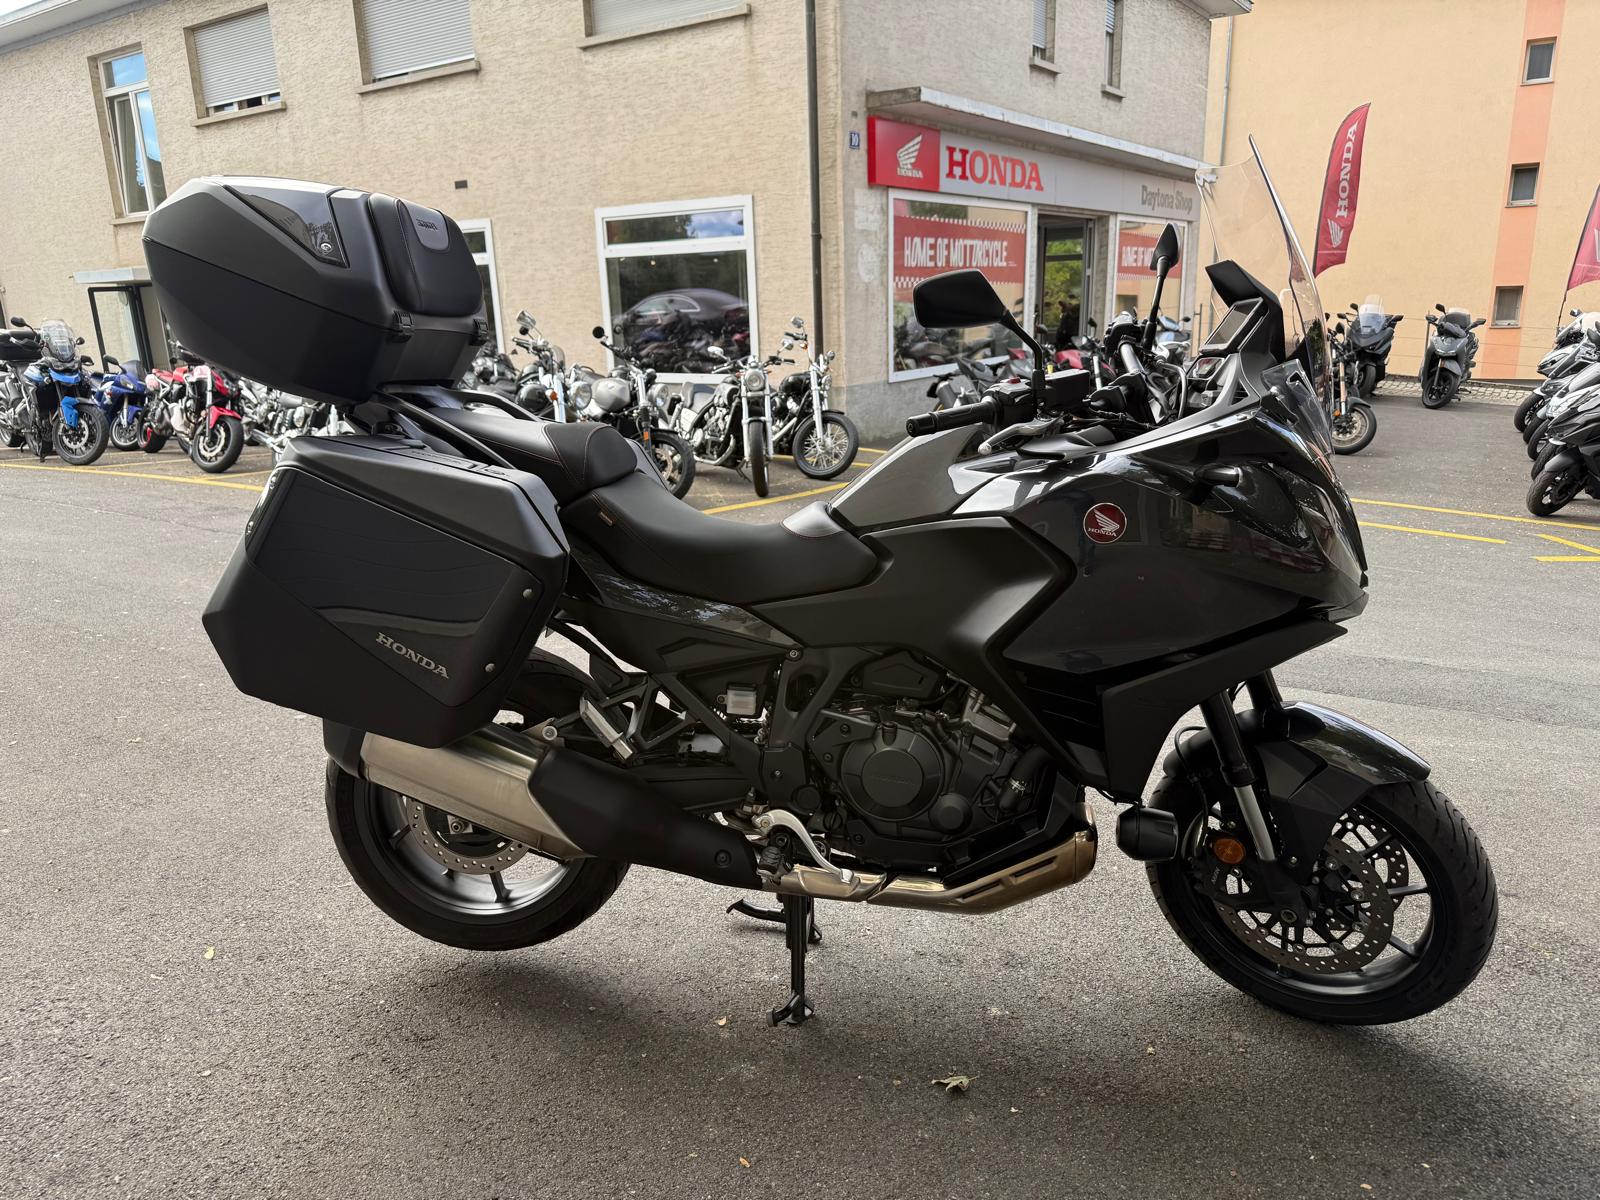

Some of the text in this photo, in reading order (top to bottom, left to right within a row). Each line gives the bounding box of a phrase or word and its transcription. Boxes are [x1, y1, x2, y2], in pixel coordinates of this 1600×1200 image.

[945, 145, 1045, 192] HONDA
[1336, 121, 1358, 218] HONDA
[1141, 184, 1193, 215] Daytona Shop
[904, 236, 936, 268] HOME
[936, 237, 949, 268] OF
[1088, 528, 1117, 537] HONDA
[375, 632, 449, 679] HONDA
